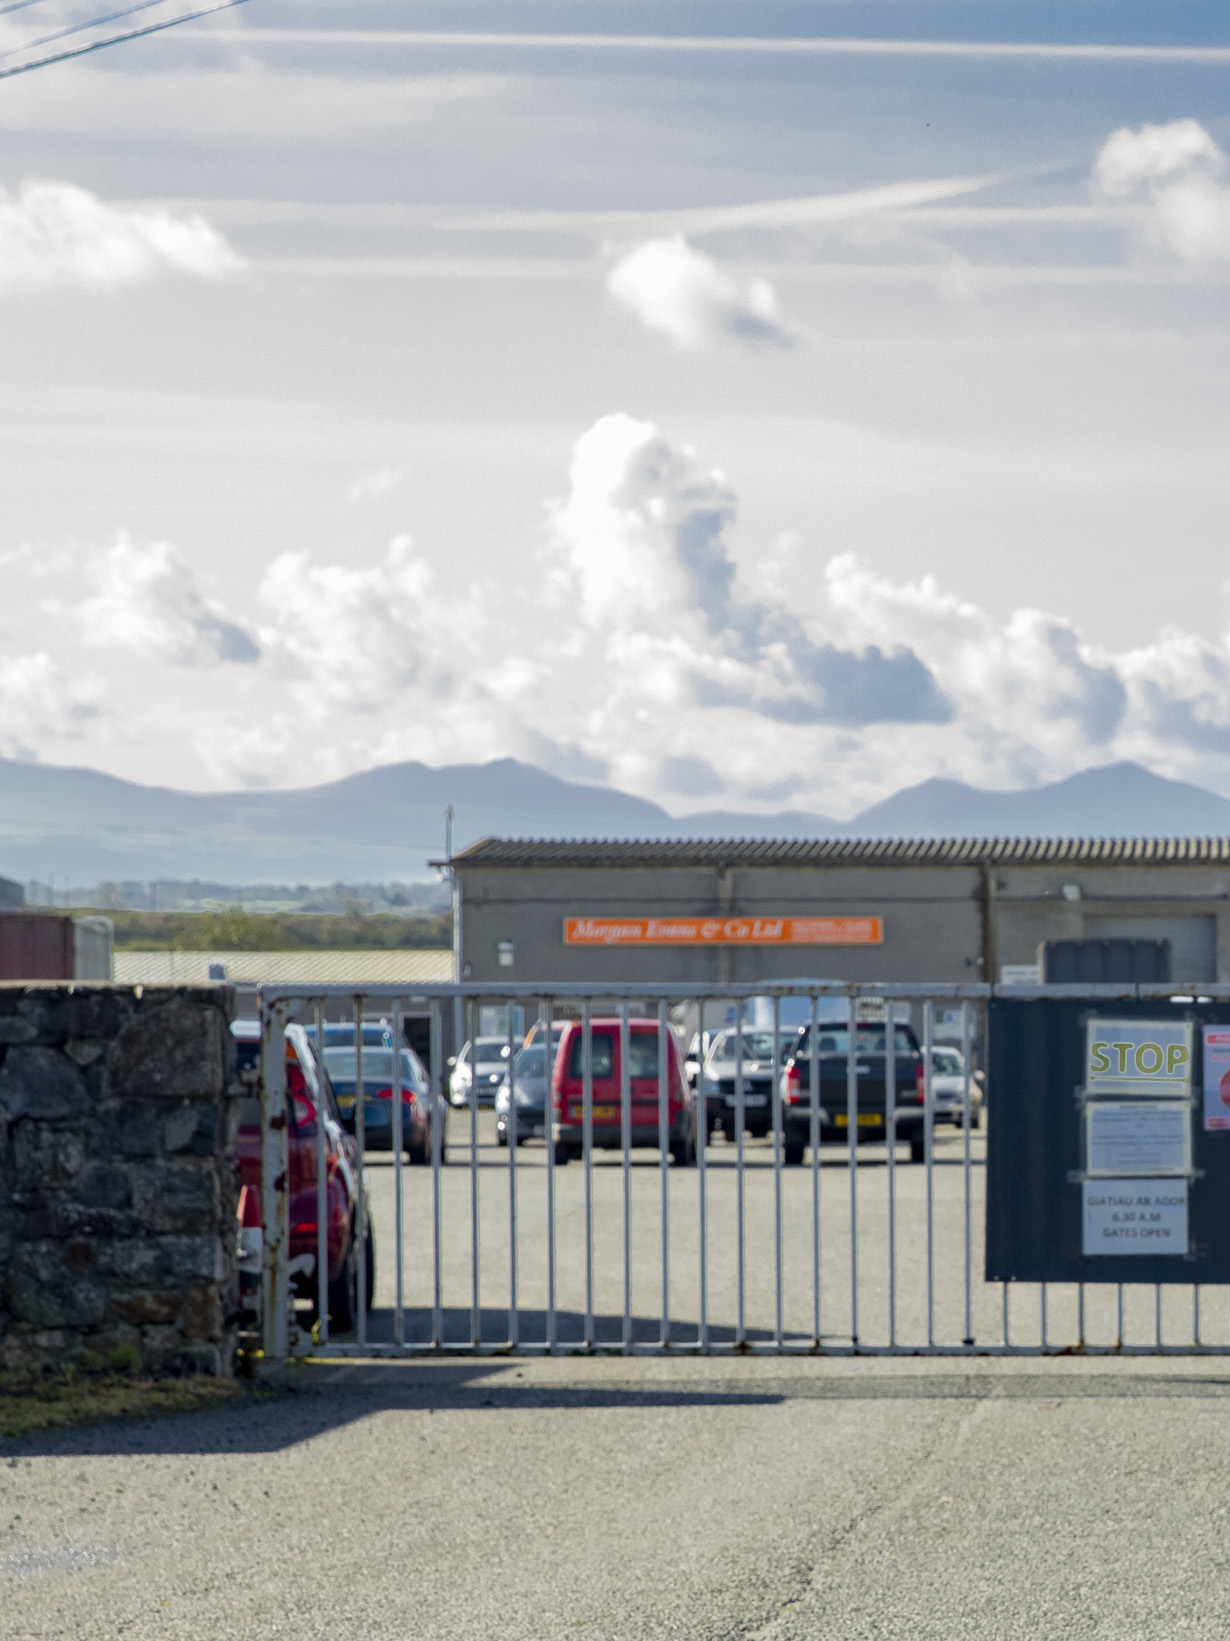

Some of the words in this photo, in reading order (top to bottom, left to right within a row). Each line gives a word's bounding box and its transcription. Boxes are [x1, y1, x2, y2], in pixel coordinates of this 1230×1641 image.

[571, 919, 642, 944] Morgan
[645, 919, 697, 939] Evans
[700, 920, 721, 939] &
[724, 919, 750, 939] Co
[752, 919, 784, 938] Ltd
[1089, 1042, 1190, 1074] STOP
[1111, 1211, 1136, 1223] 6.30
[1102, 1228, 1138, 1239] GATES
[1140, 1228, 1171, 1239] OPEN
